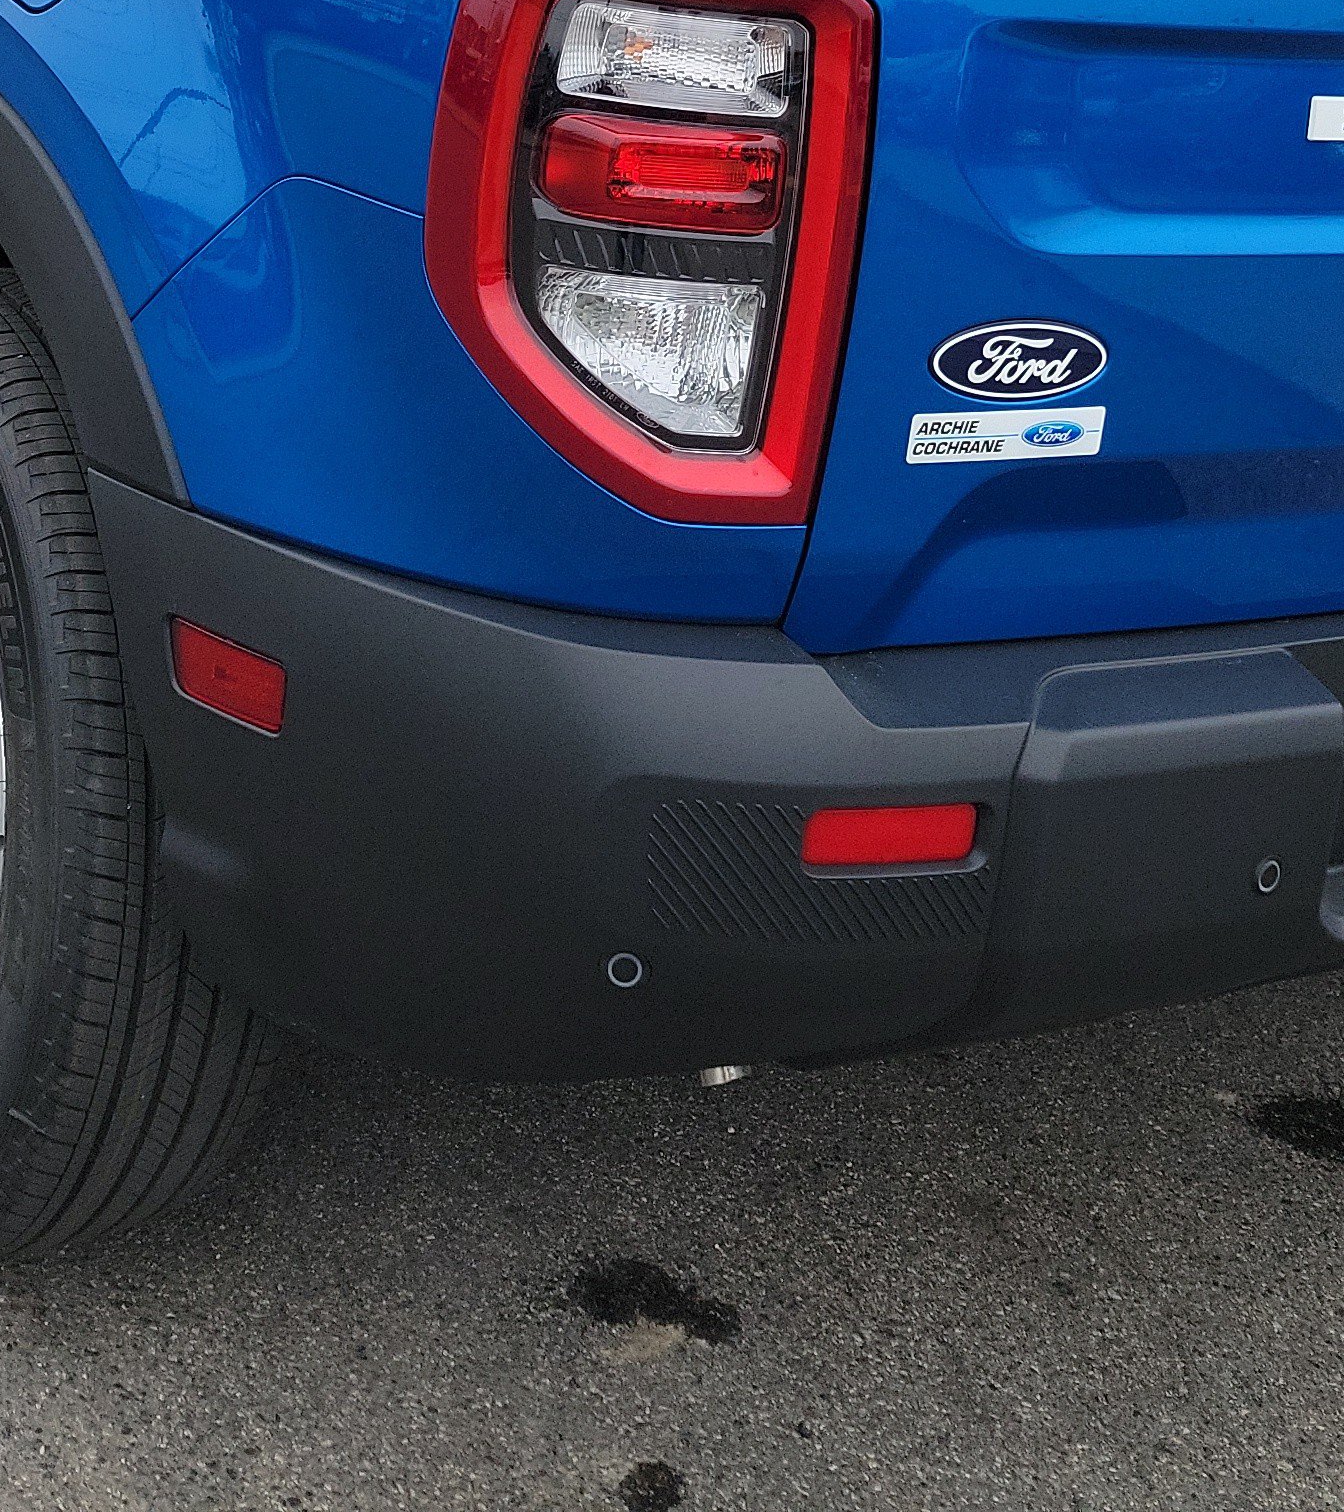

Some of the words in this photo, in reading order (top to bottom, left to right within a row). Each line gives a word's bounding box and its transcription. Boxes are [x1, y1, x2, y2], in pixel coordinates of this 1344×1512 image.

[967, 335, 1078, 384] Ford
[915, 420, 980, 436] ARCHIE
[1033, 424, 1072, 443] Ford
[912, 439, 1005, 456] COCHRANE
